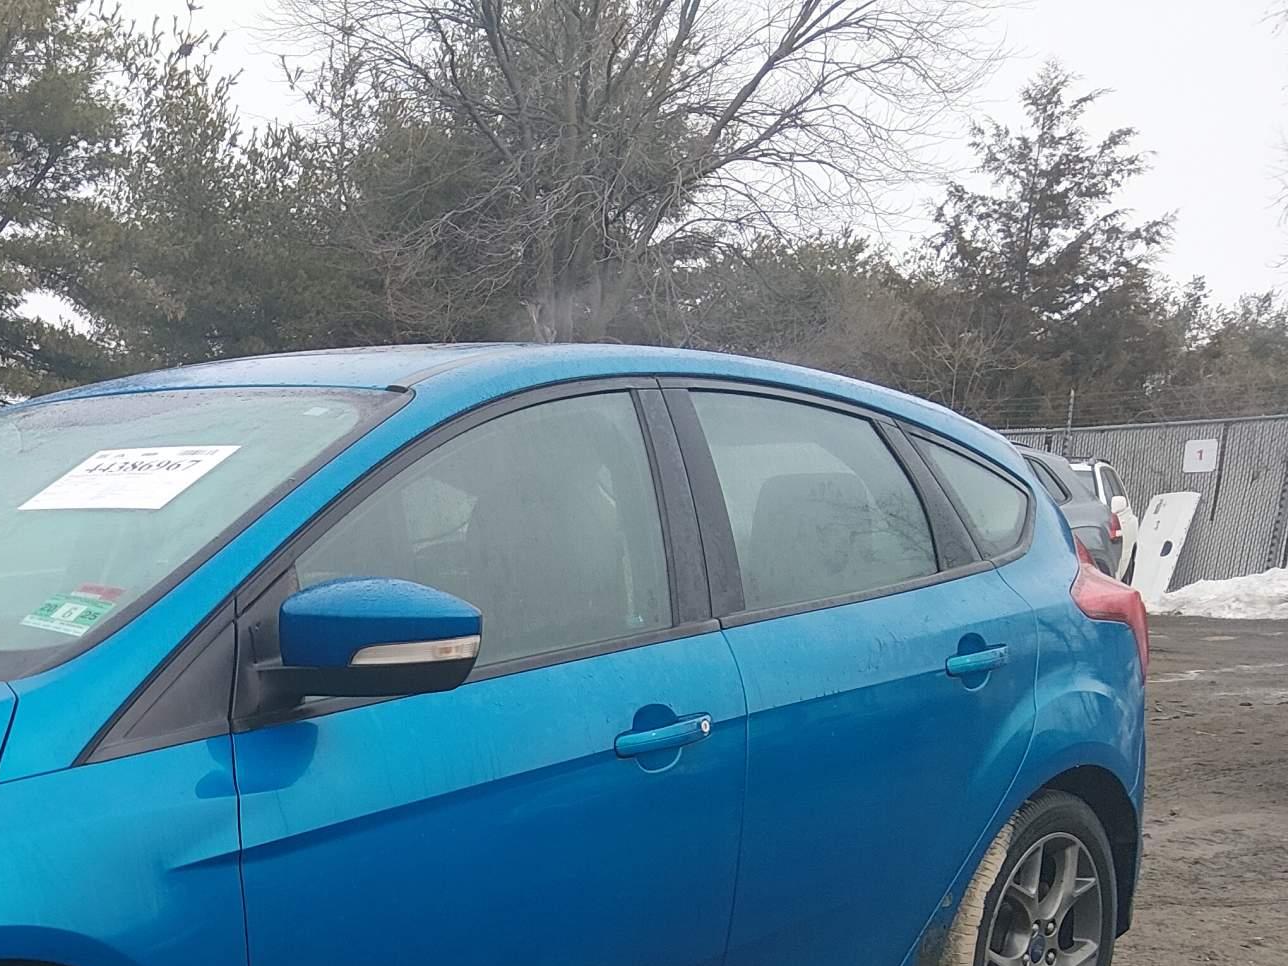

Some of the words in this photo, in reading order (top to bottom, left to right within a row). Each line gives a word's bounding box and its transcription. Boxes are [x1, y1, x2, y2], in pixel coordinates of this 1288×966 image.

[1196, 449, 1203, 460] 1
[86, 459, 203, 473] 44386967
[80, 611, 101, 620] 25
